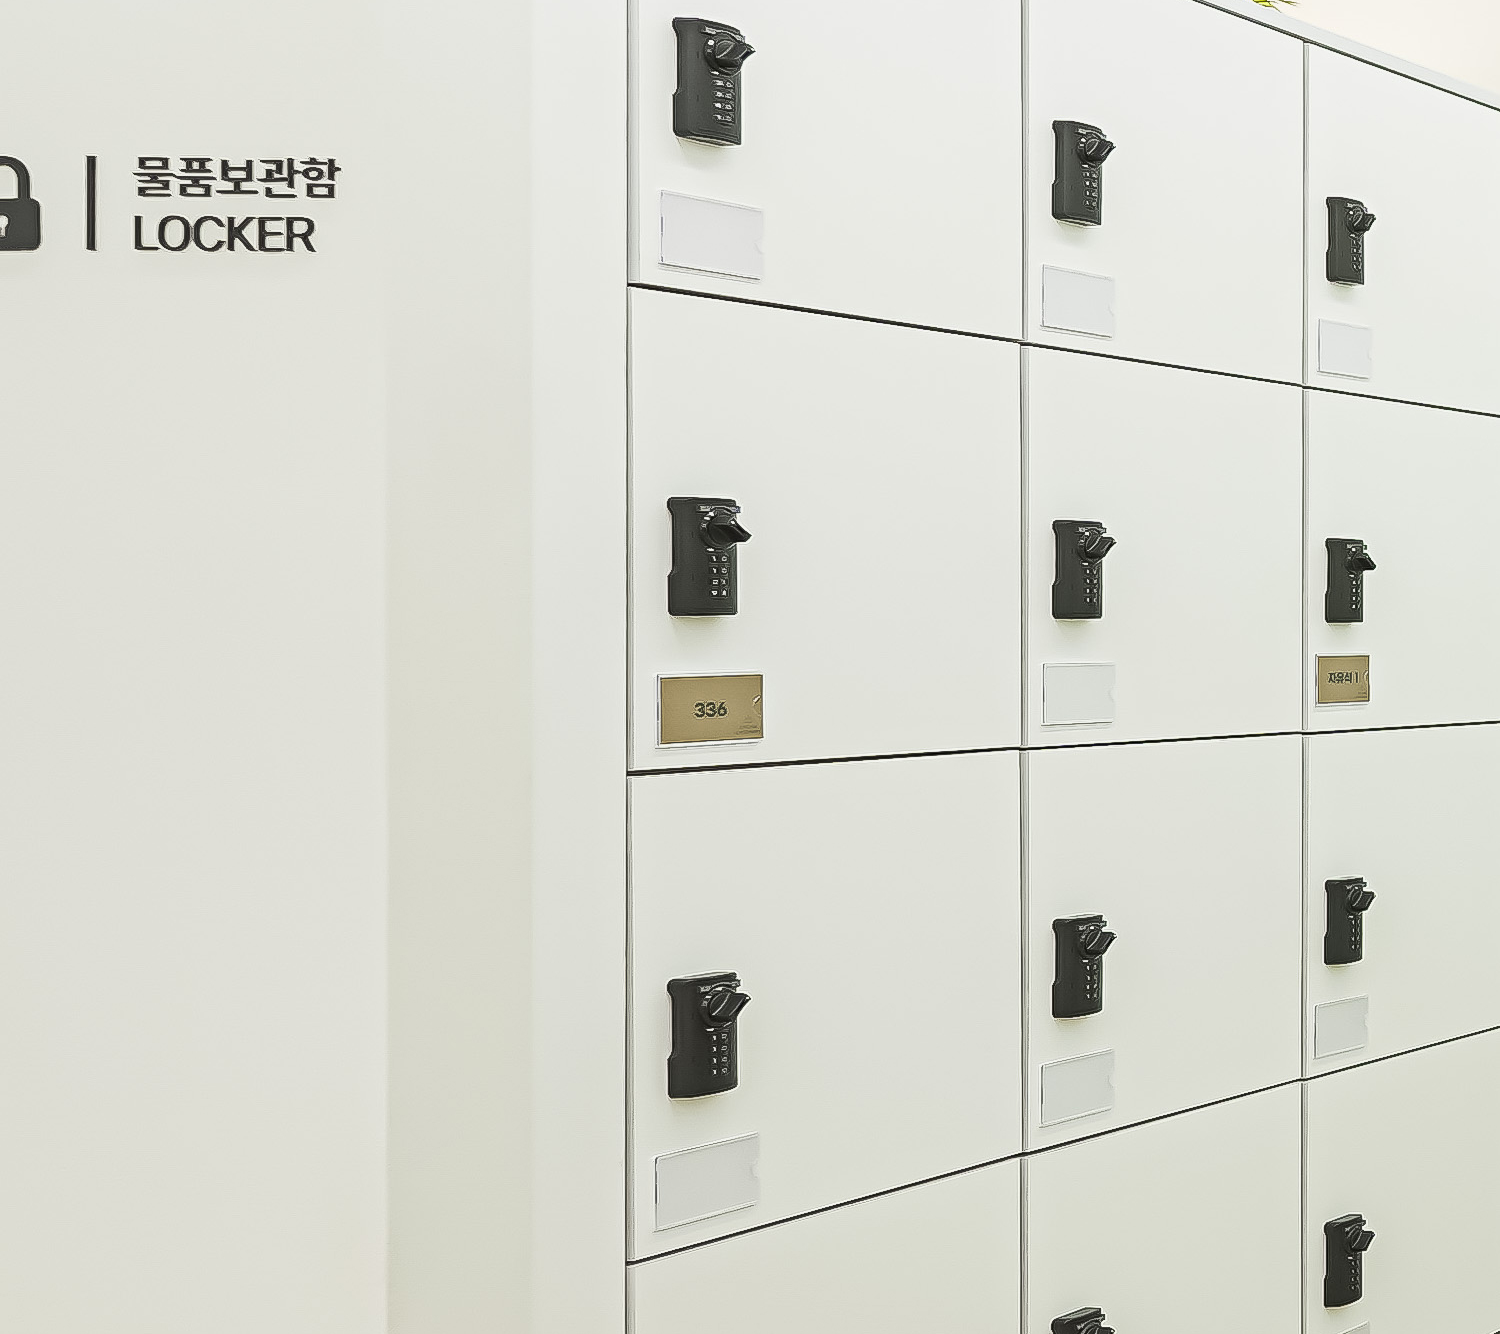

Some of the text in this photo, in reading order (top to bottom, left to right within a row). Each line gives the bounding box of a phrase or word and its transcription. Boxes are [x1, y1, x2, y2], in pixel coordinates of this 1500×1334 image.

[133, 156, 341, 199] 물품보관함
[133, 215, 317, 253] LOCKER
[694, 701, 728, 718] 336
